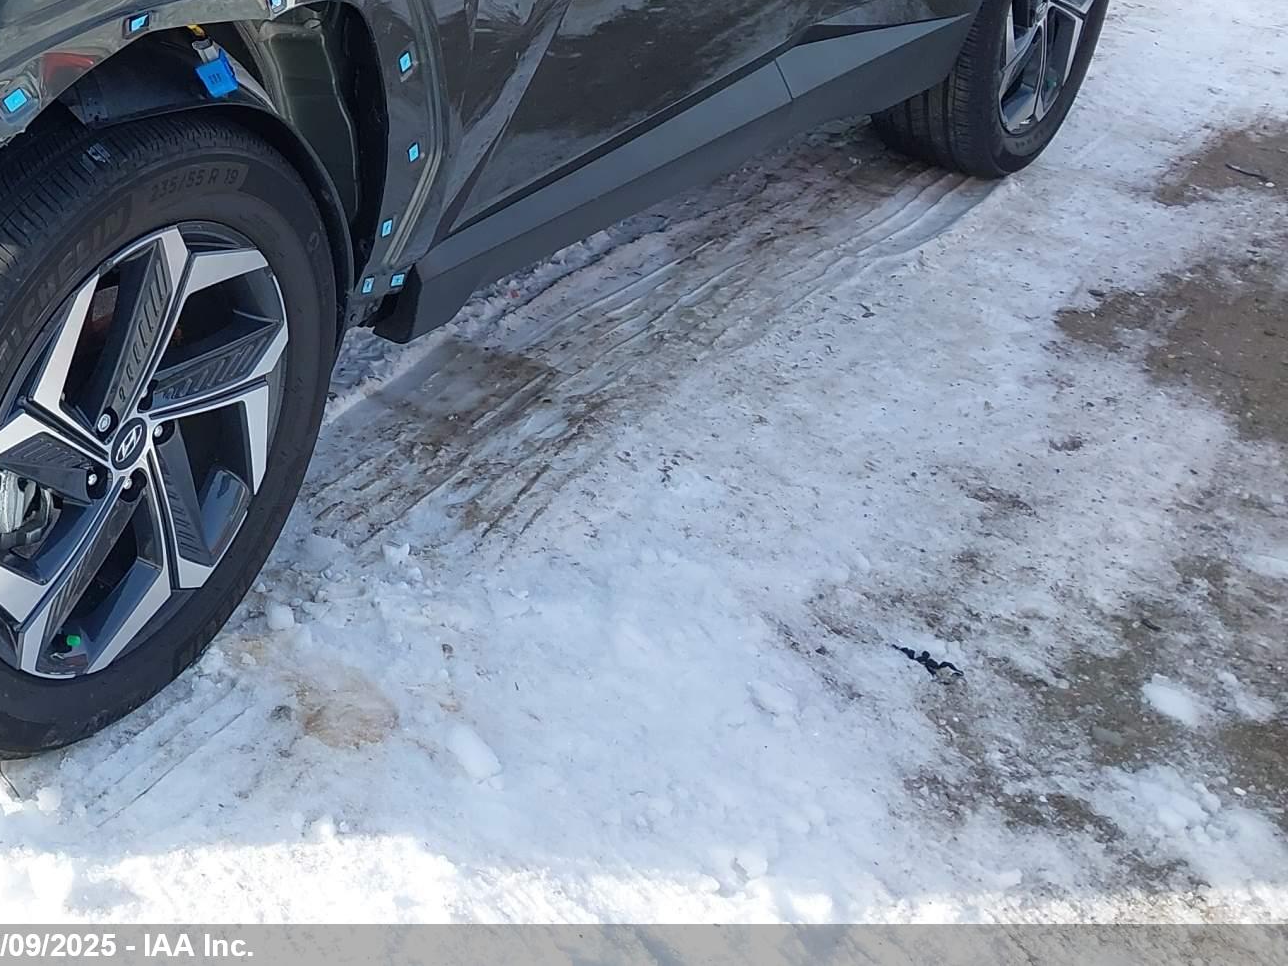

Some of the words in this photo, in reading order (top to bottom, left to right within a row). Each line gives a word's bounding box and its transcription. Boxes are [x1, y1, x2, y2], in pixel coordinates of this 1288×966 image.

[149, 168, 206, 202] 235/55
[207, 167, 220, 185] R
[224, 167, 240, 186] 19
